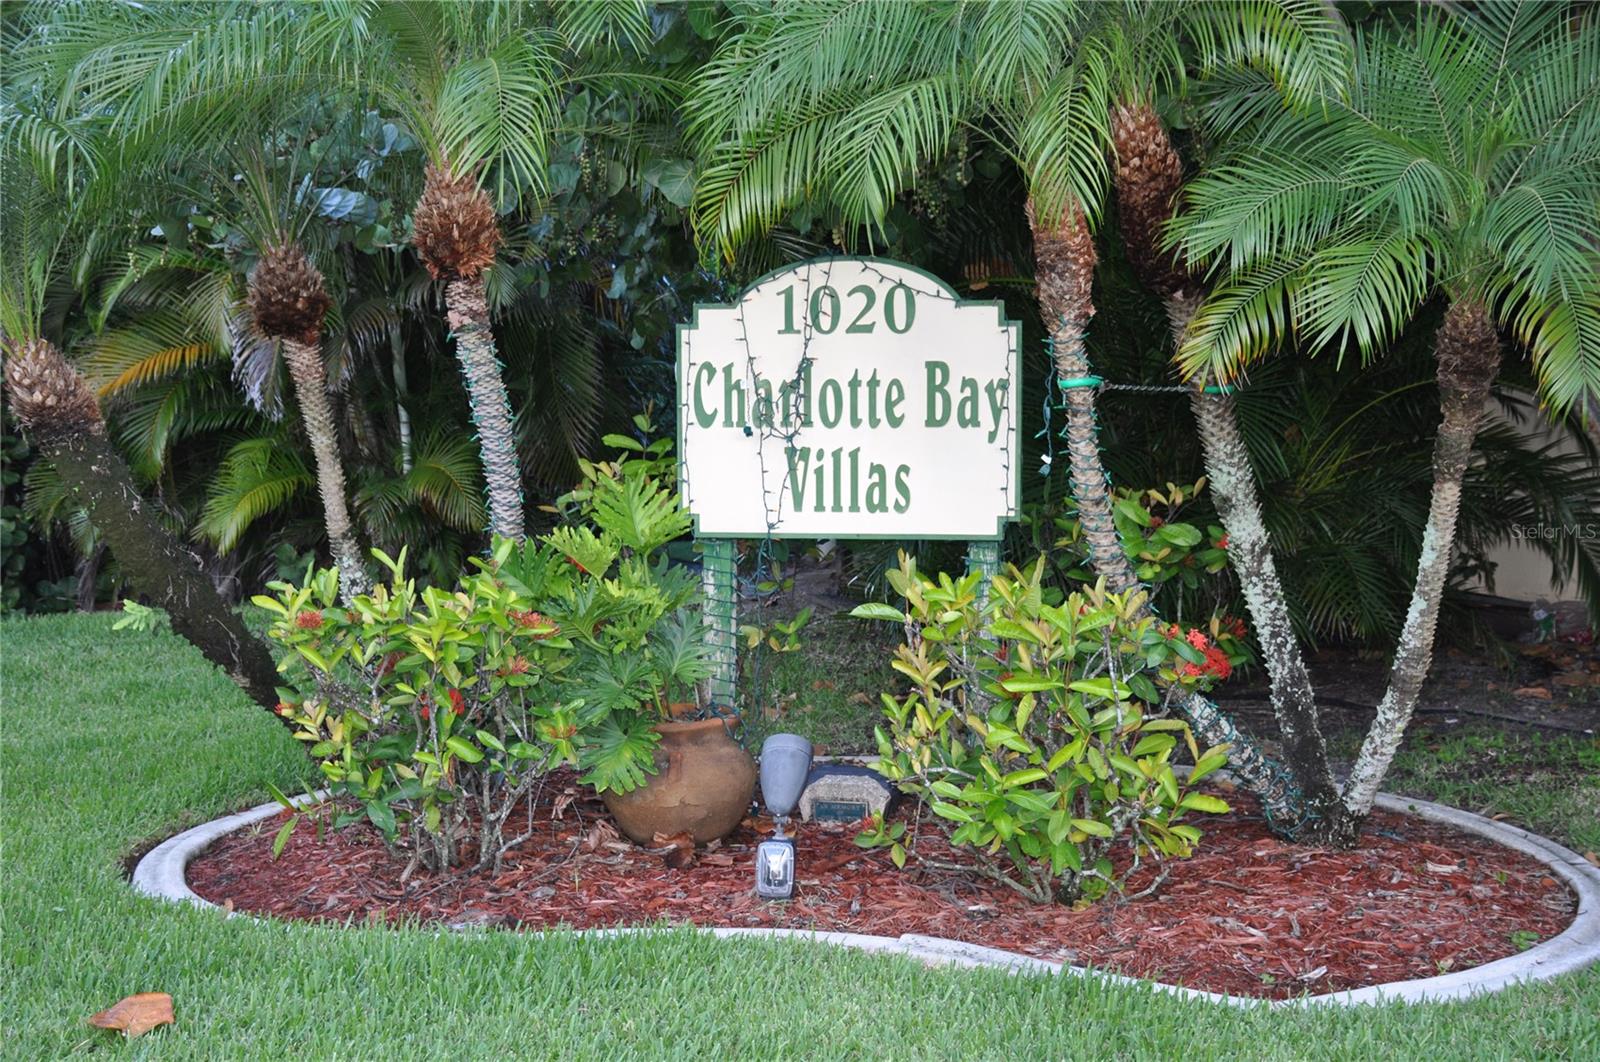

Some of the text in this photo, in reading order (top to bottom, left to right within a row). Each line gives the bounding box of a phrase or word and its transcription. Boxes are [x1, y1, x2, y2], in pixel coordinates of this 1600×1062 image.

[776, 284, 916, 334] 1020
[693, 360, 1009, 444] Charlotte Bay
[784, 447, 911, 514] Villas
